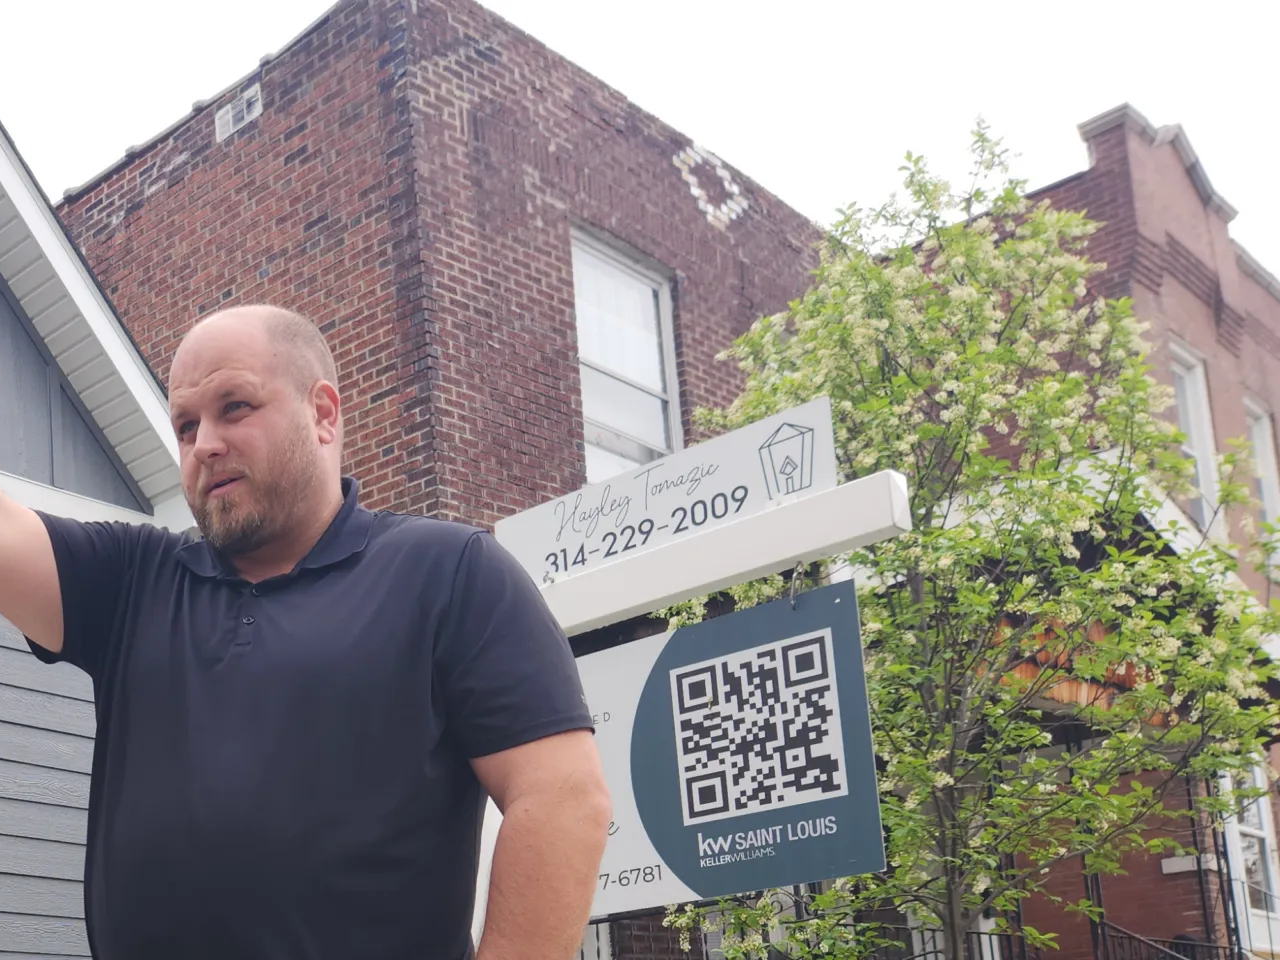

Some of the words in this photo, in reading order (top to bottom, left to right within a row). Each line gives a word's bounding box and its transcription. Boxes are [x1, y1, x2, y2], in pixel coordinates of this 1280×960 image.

[545, 485, 749, 573] 314-229-2009
[554, 484, 632, 541] Hayley
[634, 463, 719, 511] Tomazic
[697, 833, 733, 857] kw
[735, 825, 783, 850] SAINT
[787, 816, 837, 841] LOUIS
[598, 864, 663, 890] 7-6781
